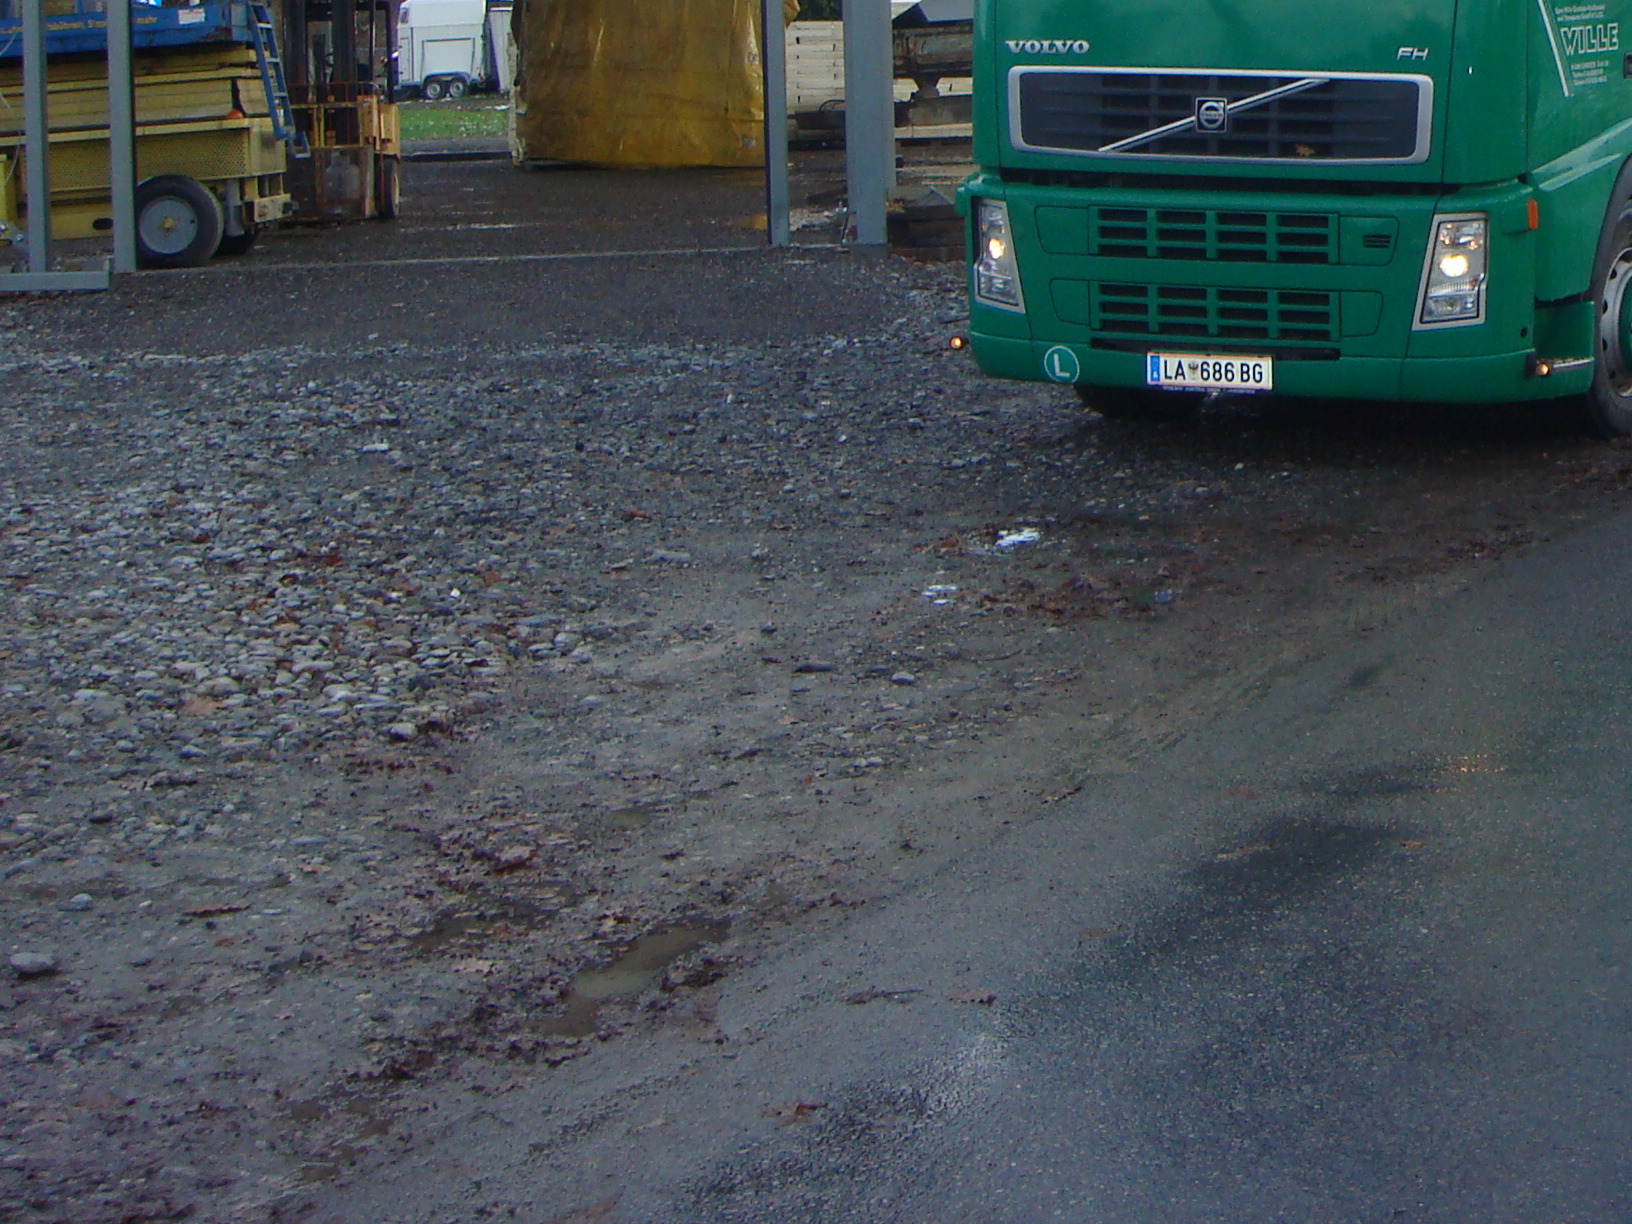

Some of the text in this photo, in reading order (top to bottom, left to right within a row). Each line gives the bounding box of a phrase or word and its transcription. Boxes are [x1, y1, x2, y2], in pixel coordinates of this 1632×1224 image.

[1004, 39, 1090, 55] VOLVO
[1560, 22, 1619, 57] WILLE
[1396, 47, 1429, 61] FH
[1053, 353, 1071, 378] L
[1163, 359, 1264, 384] LA 686 BG
